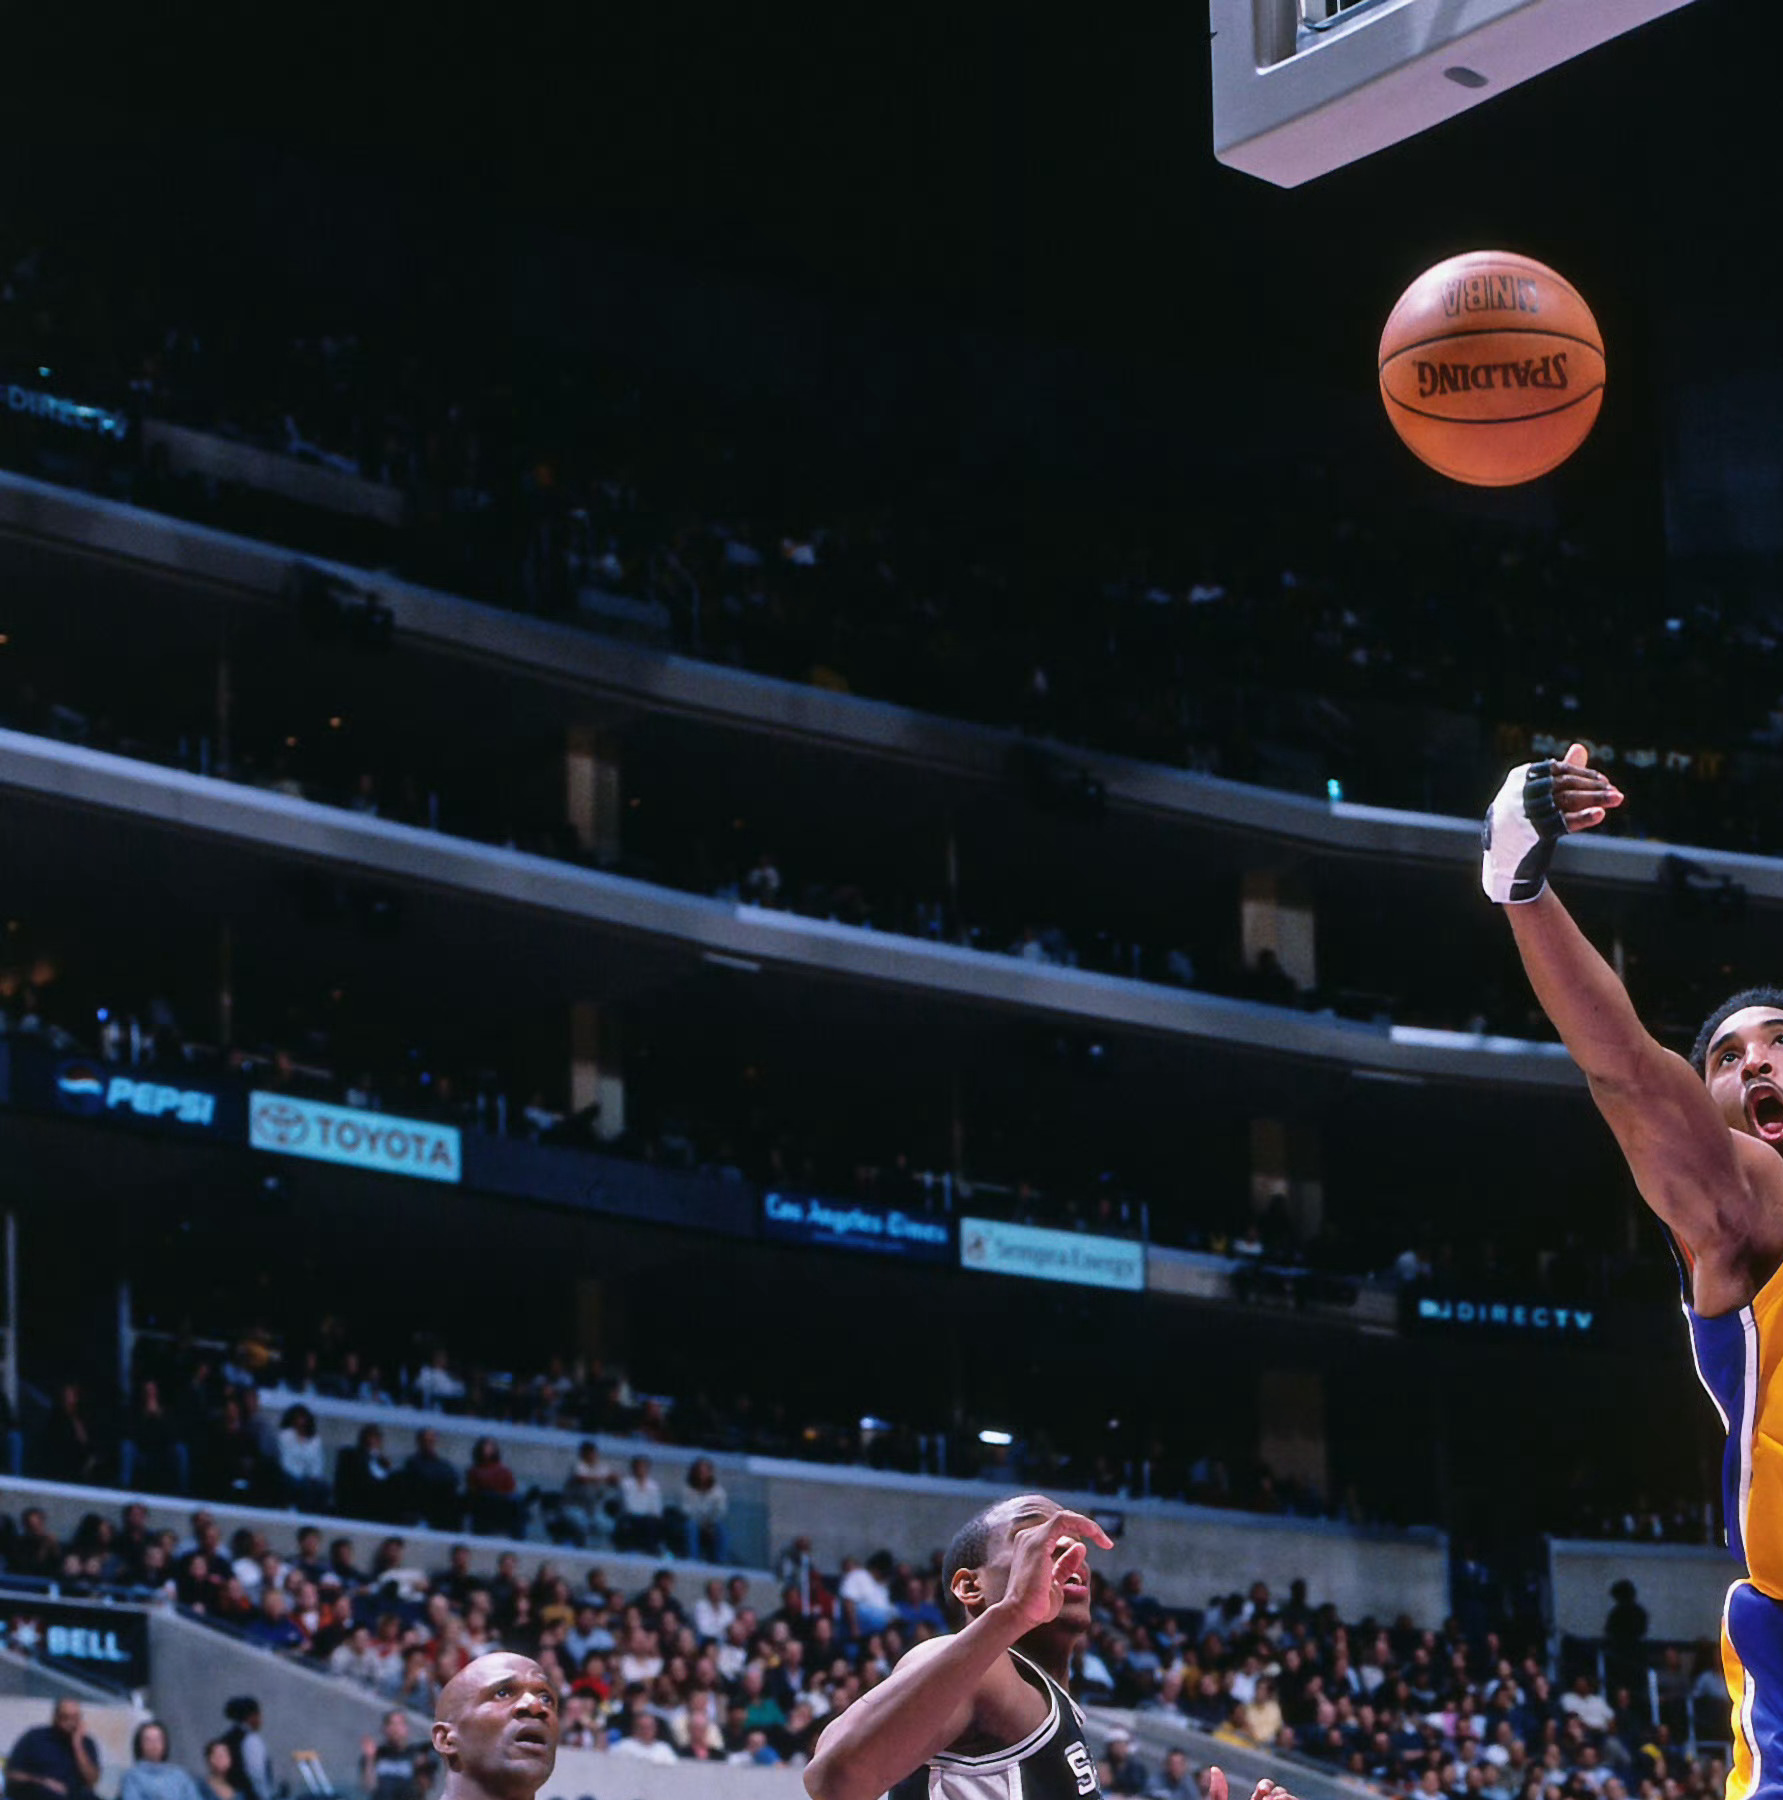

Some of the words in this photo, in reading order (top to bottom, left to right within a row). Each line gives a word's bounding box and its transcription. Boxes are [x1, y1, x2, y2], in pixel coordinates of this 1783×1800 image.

[1441, 275, 1517, 317] NBA
[1418, 352, 1568, 398] SPALDING
[107, 1076, 215, 1125] PEPSI
[315, 1116, 452, 1167] TOYOTA
[1457, 1301, 1593, 1329] DIRECTV
[47, 1625, 132, 1662] BELL
